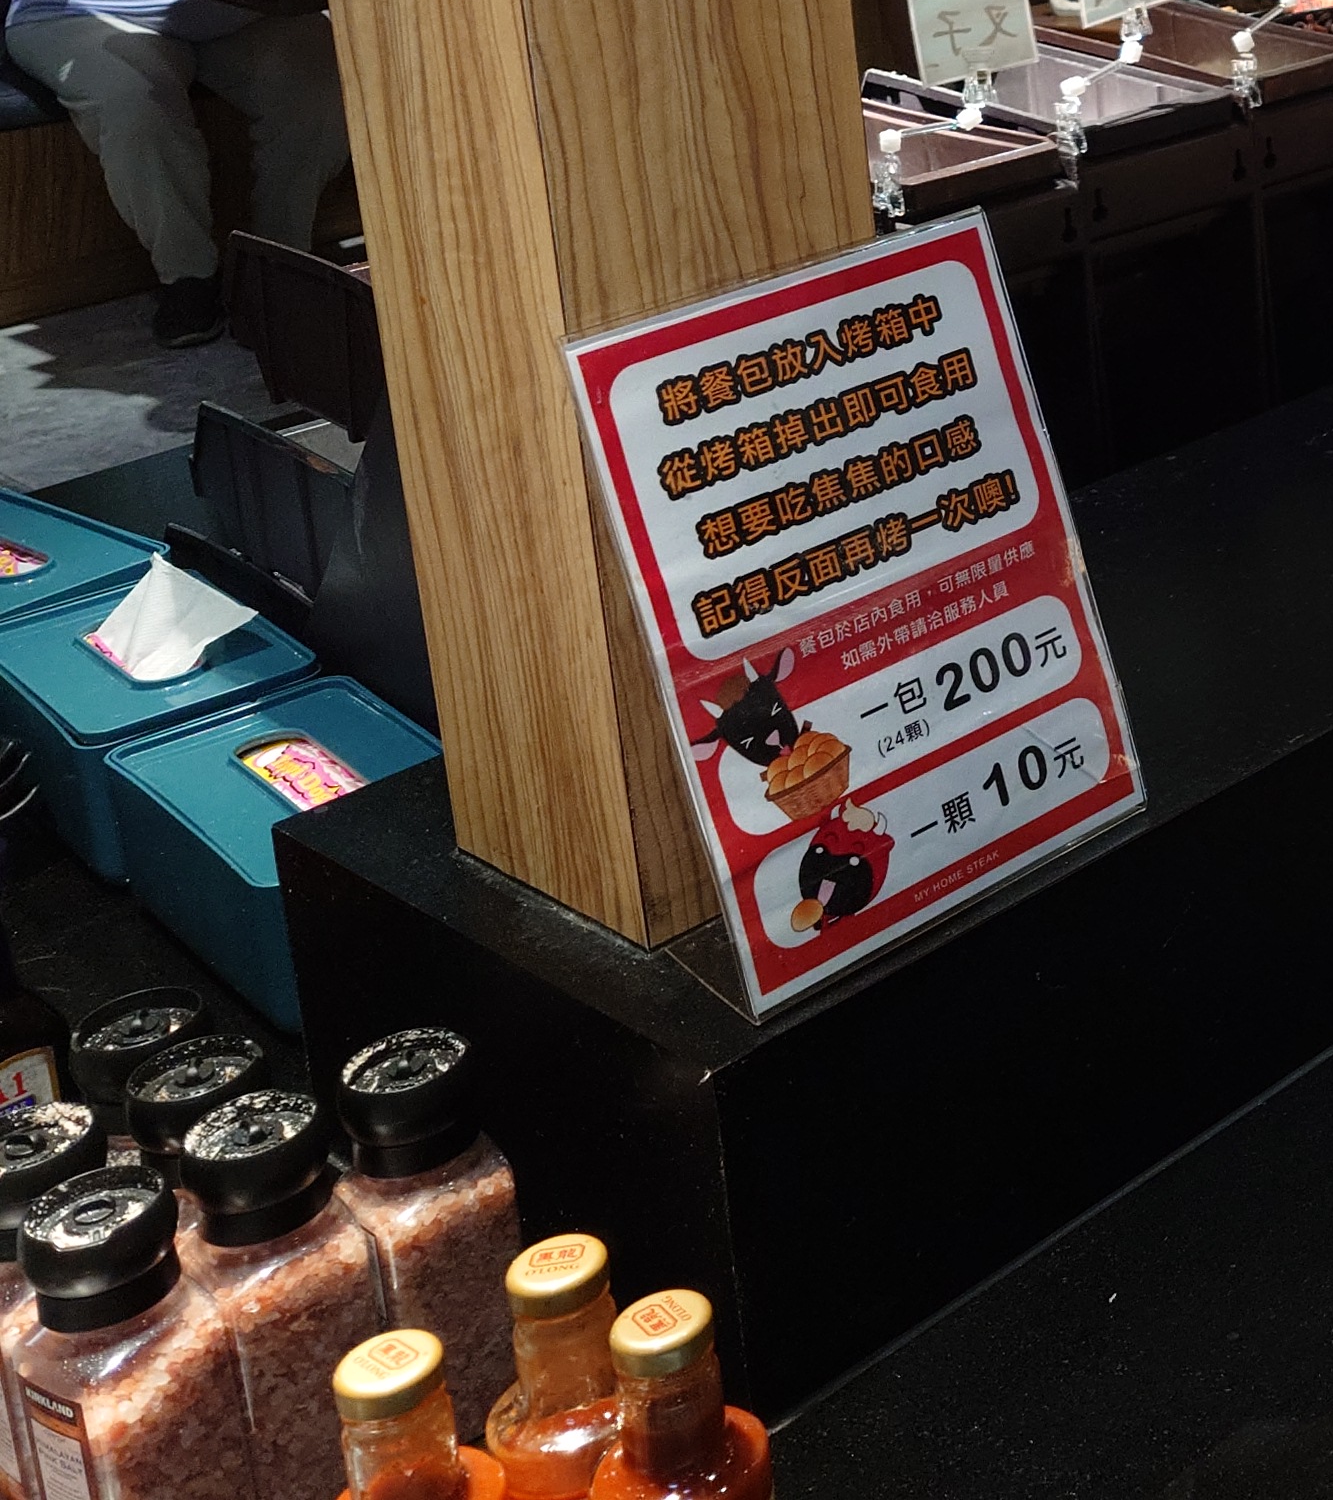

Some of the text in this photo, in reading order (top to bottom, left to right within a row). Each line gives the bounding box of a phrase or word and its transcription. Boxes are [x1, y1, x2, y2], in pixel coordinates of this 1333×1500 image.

[657, 293, 943, 426] 將餐包放入烤箱中
[658, 347, 979, 500] 從烤箱掉出即可食用
[696, 414, 981, 558] 想要吃焦焦的口感
[841, 581, 1009, 670] 如需外帶請洽服務人員
[877, 719, 930, 758] (24顆)
[914, 850, 1000, 903] MY HOME STEAK
[24, 1386, 74, 1419] KIRKLAND
